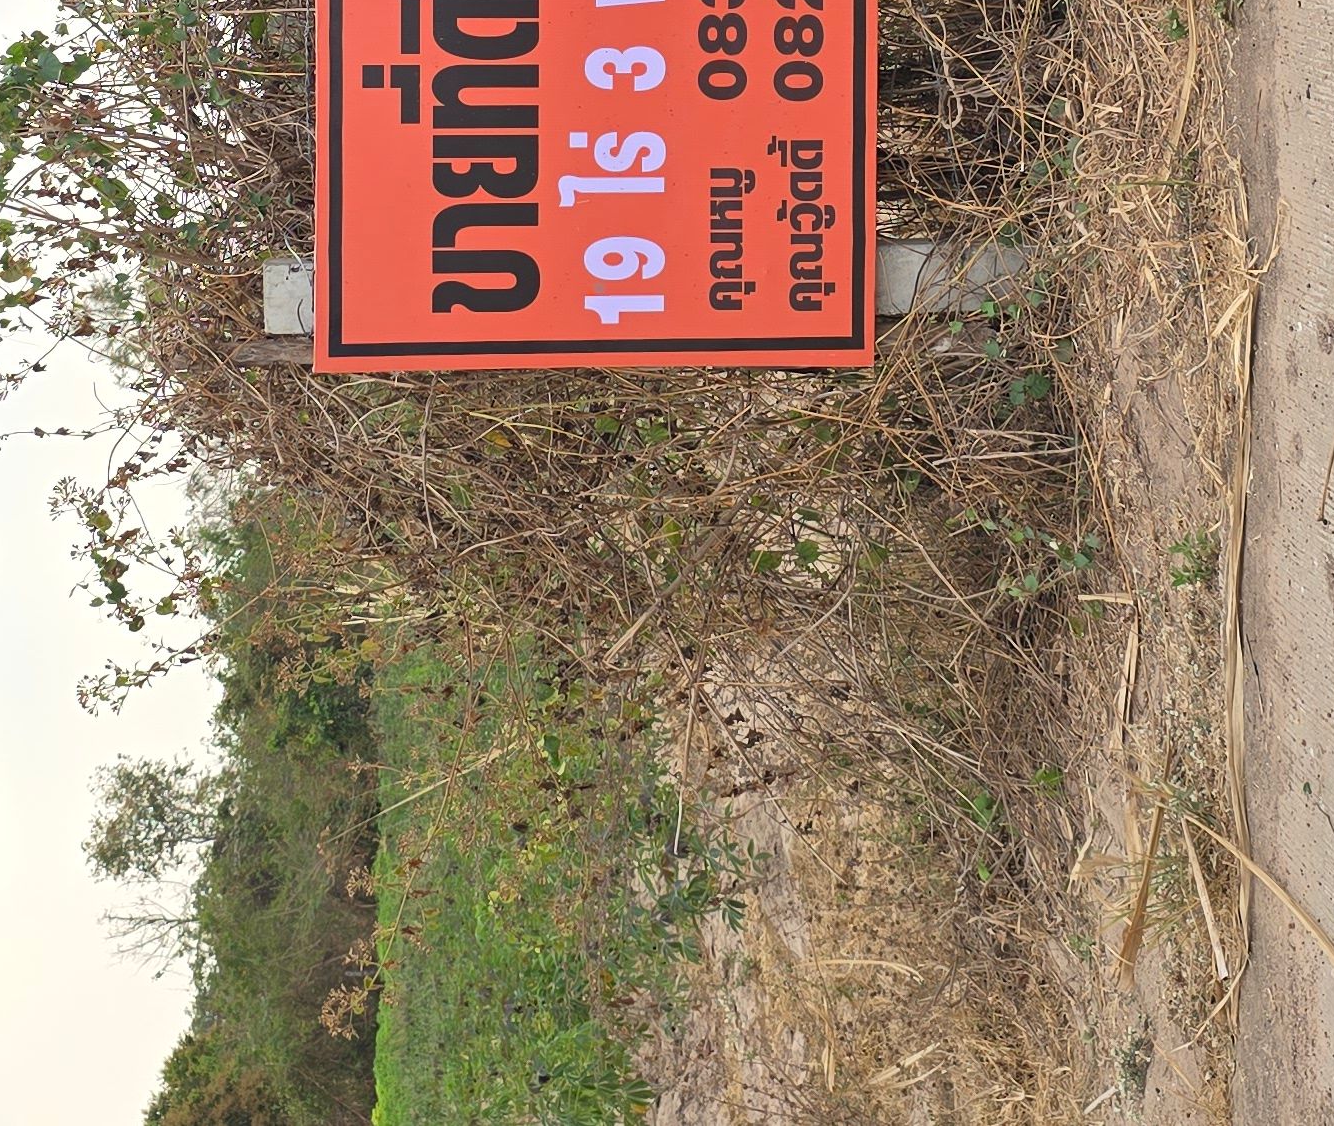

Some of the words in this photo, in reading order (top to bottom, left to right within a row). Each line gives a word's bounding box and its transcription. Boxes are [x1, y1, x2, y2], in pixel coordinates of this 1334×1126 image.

[584, 45, 667, 92] 3
[557, 131, 667, 207] ไร่
[708, 167, 756, 311] คุณหมู
[767, 135, 836, 312] คุณวู้ดดี้
[583, 236, 666, 325] 19
